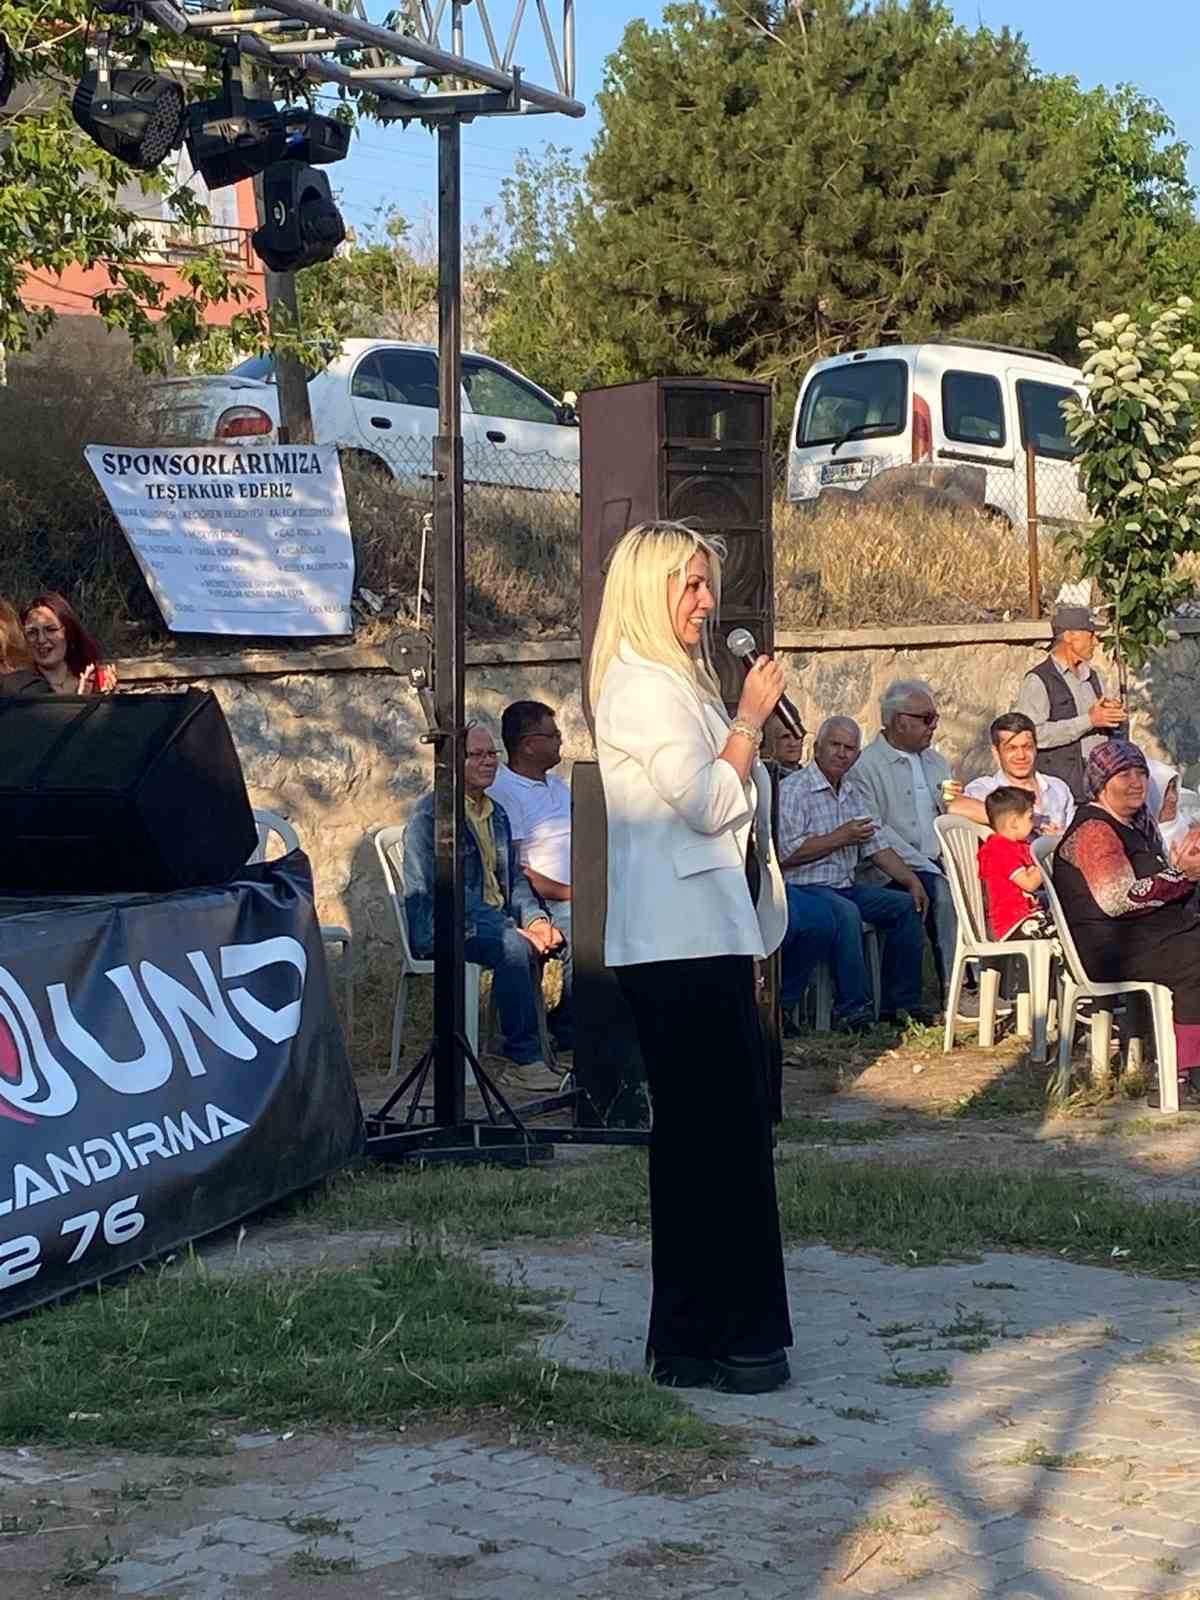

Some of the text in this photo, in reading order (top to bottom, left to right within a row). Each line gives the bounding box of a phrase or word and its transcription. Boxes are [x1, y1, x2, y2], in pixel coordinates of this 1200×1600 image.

[102, 452, 322, 476] SPONSORLARIMIZA
[146, 479, 234, 504] TEŞEKKÜR
[60, 1194, 145, 1264] 76
